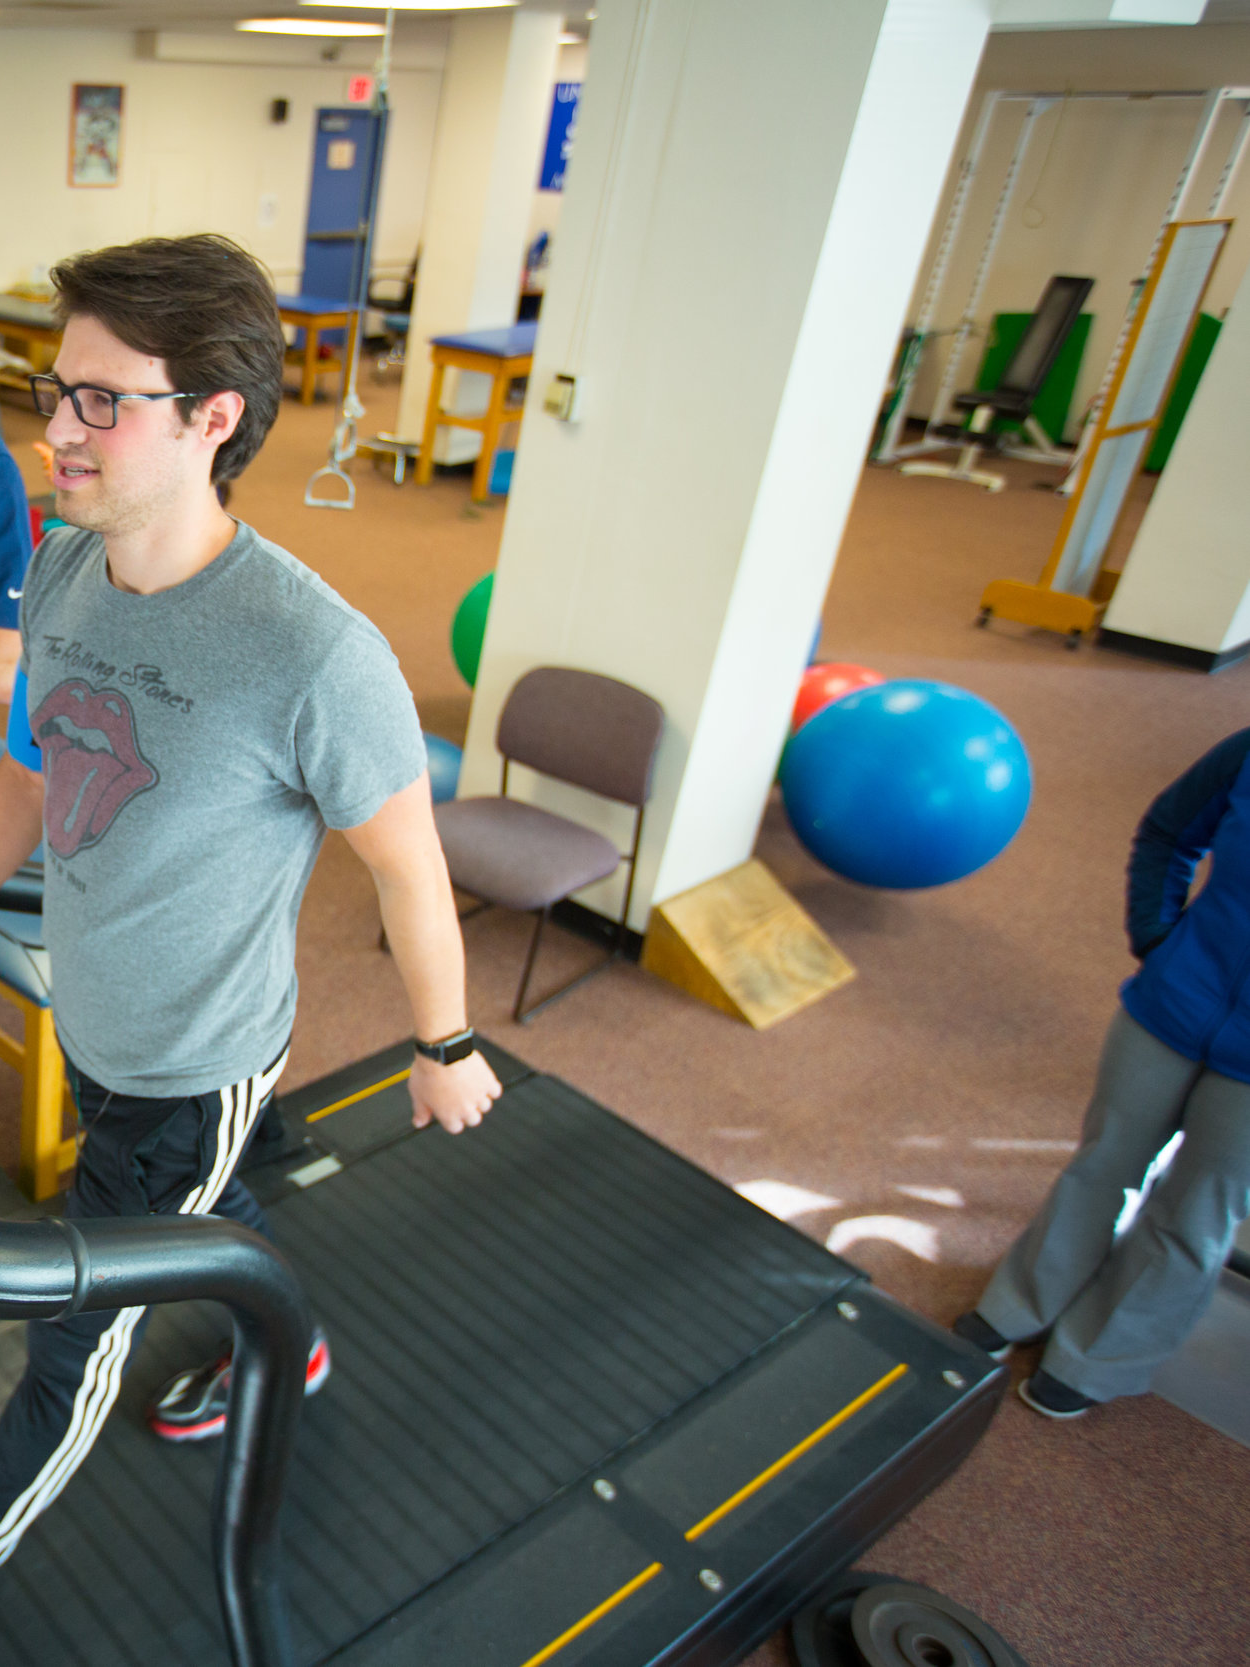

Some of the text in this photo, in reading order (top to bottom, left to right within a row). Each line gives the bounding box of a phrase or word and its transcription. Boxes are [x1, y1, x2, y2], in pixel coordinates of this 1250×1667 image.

[43, 634, 194, 714] The Rolling Stones
